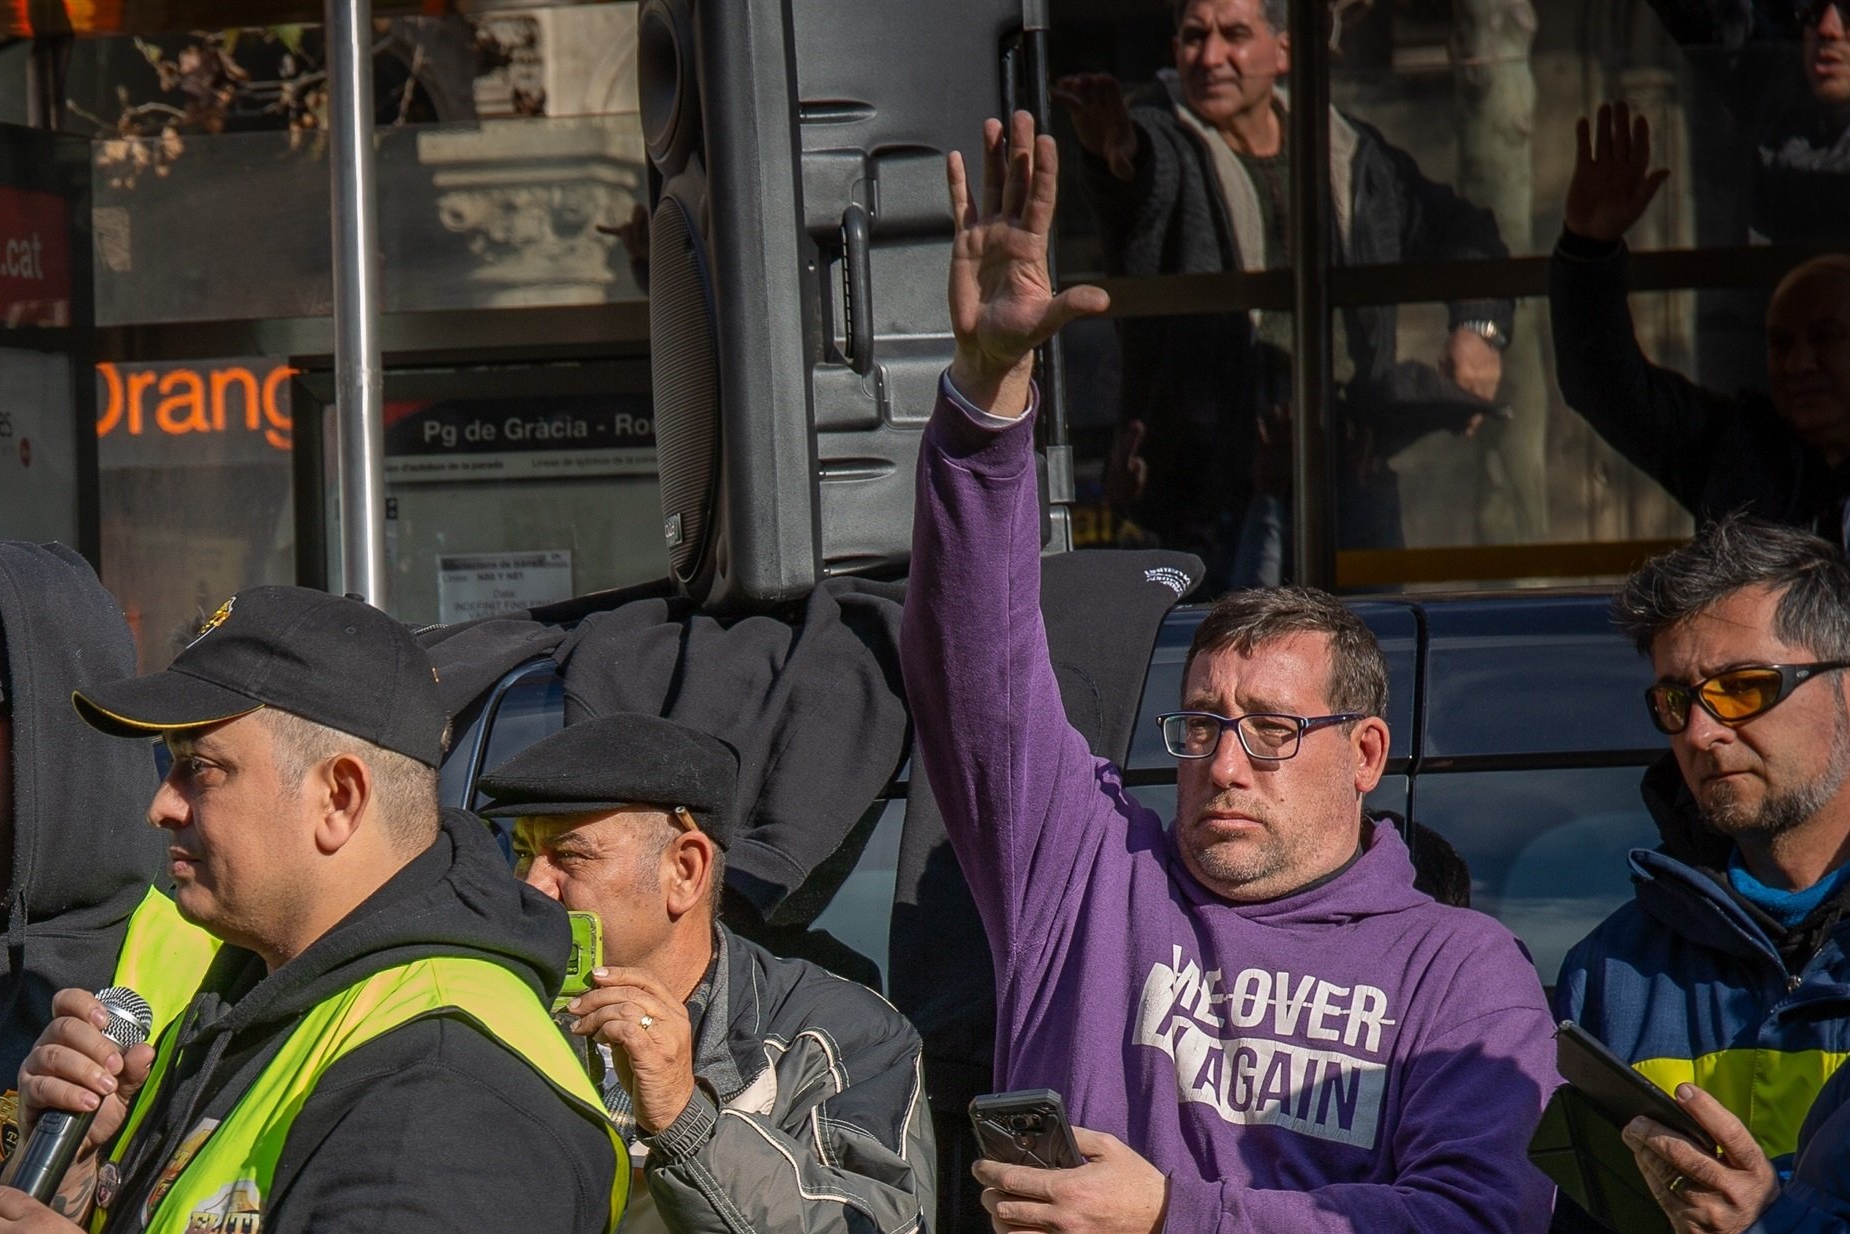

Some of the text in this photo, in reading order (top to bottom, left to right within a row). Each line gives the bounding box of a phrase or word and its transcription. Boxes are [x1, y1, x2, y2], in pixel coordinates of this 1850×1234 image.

[423, 420, 457, 448] Pg
[465, 418, 496, 442] de
[504, 414, 588, 441] Gràcia
[1230, 967, 1390, 1053] OVER
[1191, 1044, 1363, 1132] AGAIN
